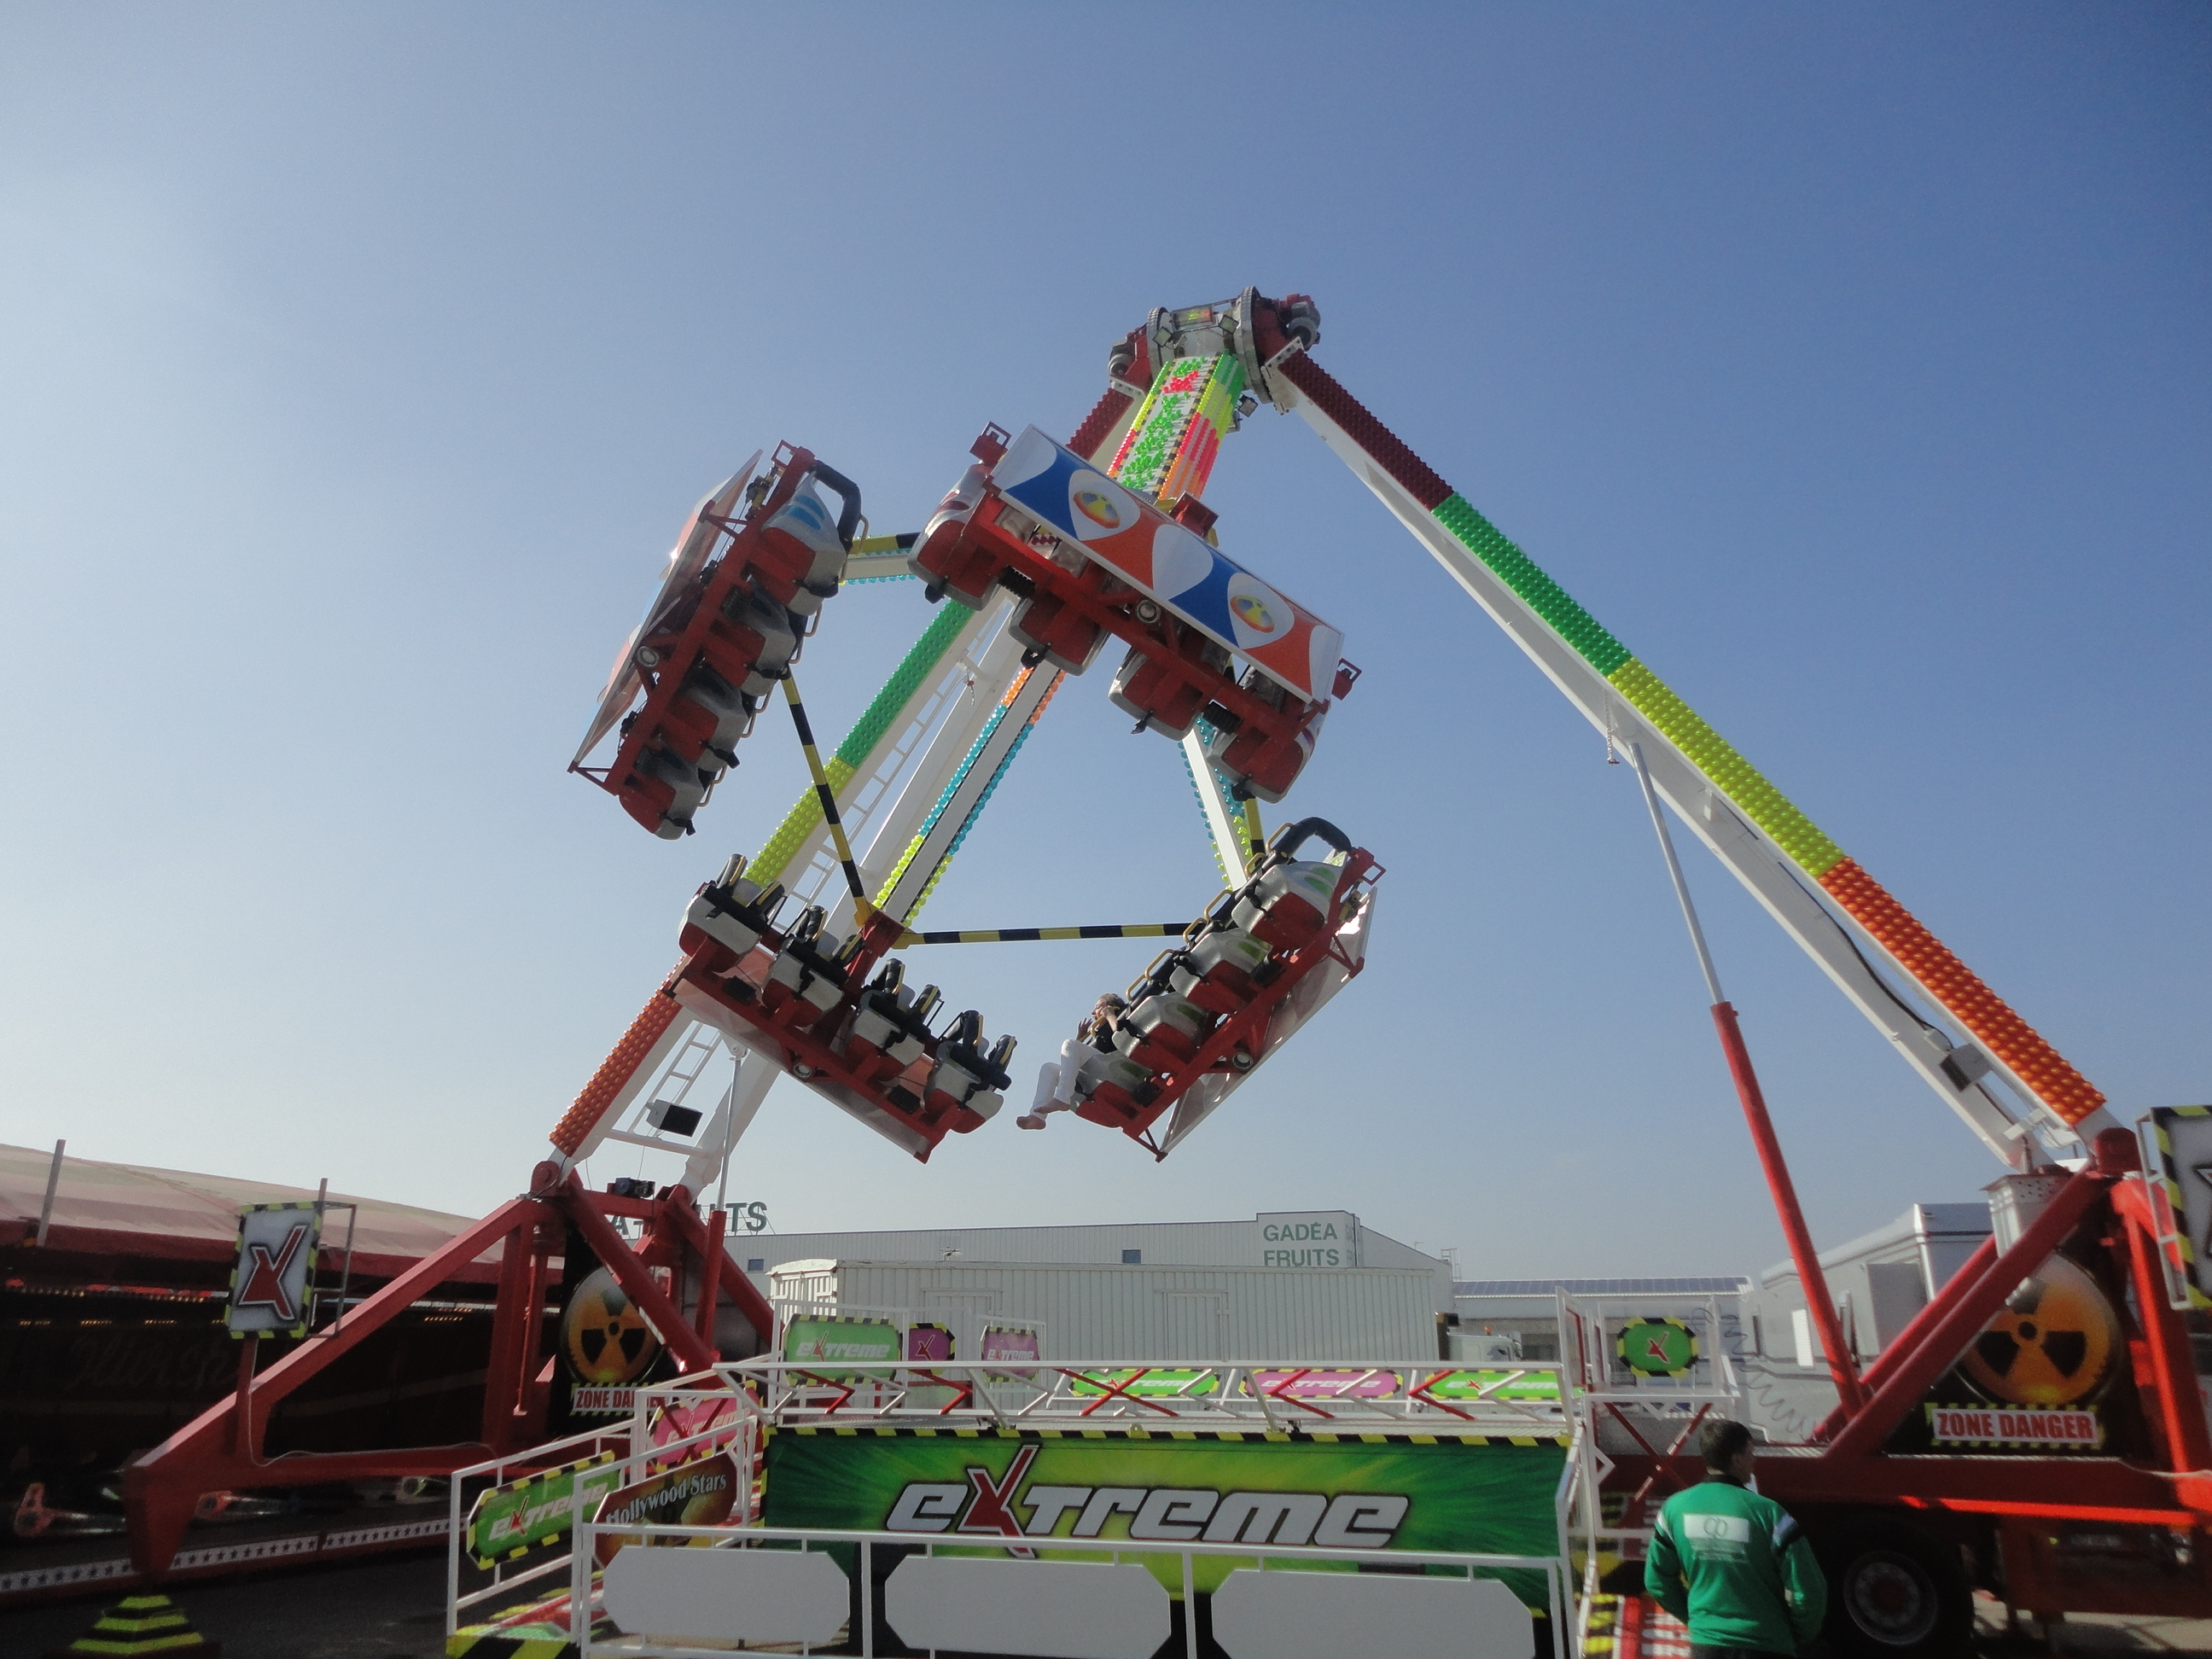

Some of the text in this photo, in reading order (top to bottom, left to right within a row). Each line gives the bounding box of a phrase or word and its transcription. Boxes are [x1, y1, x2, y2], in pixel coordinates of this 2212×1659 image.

[1263, 1222, 1338, 1242] GADÉA
[1264, 1249, 1340, 1266] FRUITS
[575, 1390, 610, 1409] ZONE
[1936, 1412, 2094, 1440] ZONE DANGER
[606, 1474, 727, 1526] Hollywood Stars
